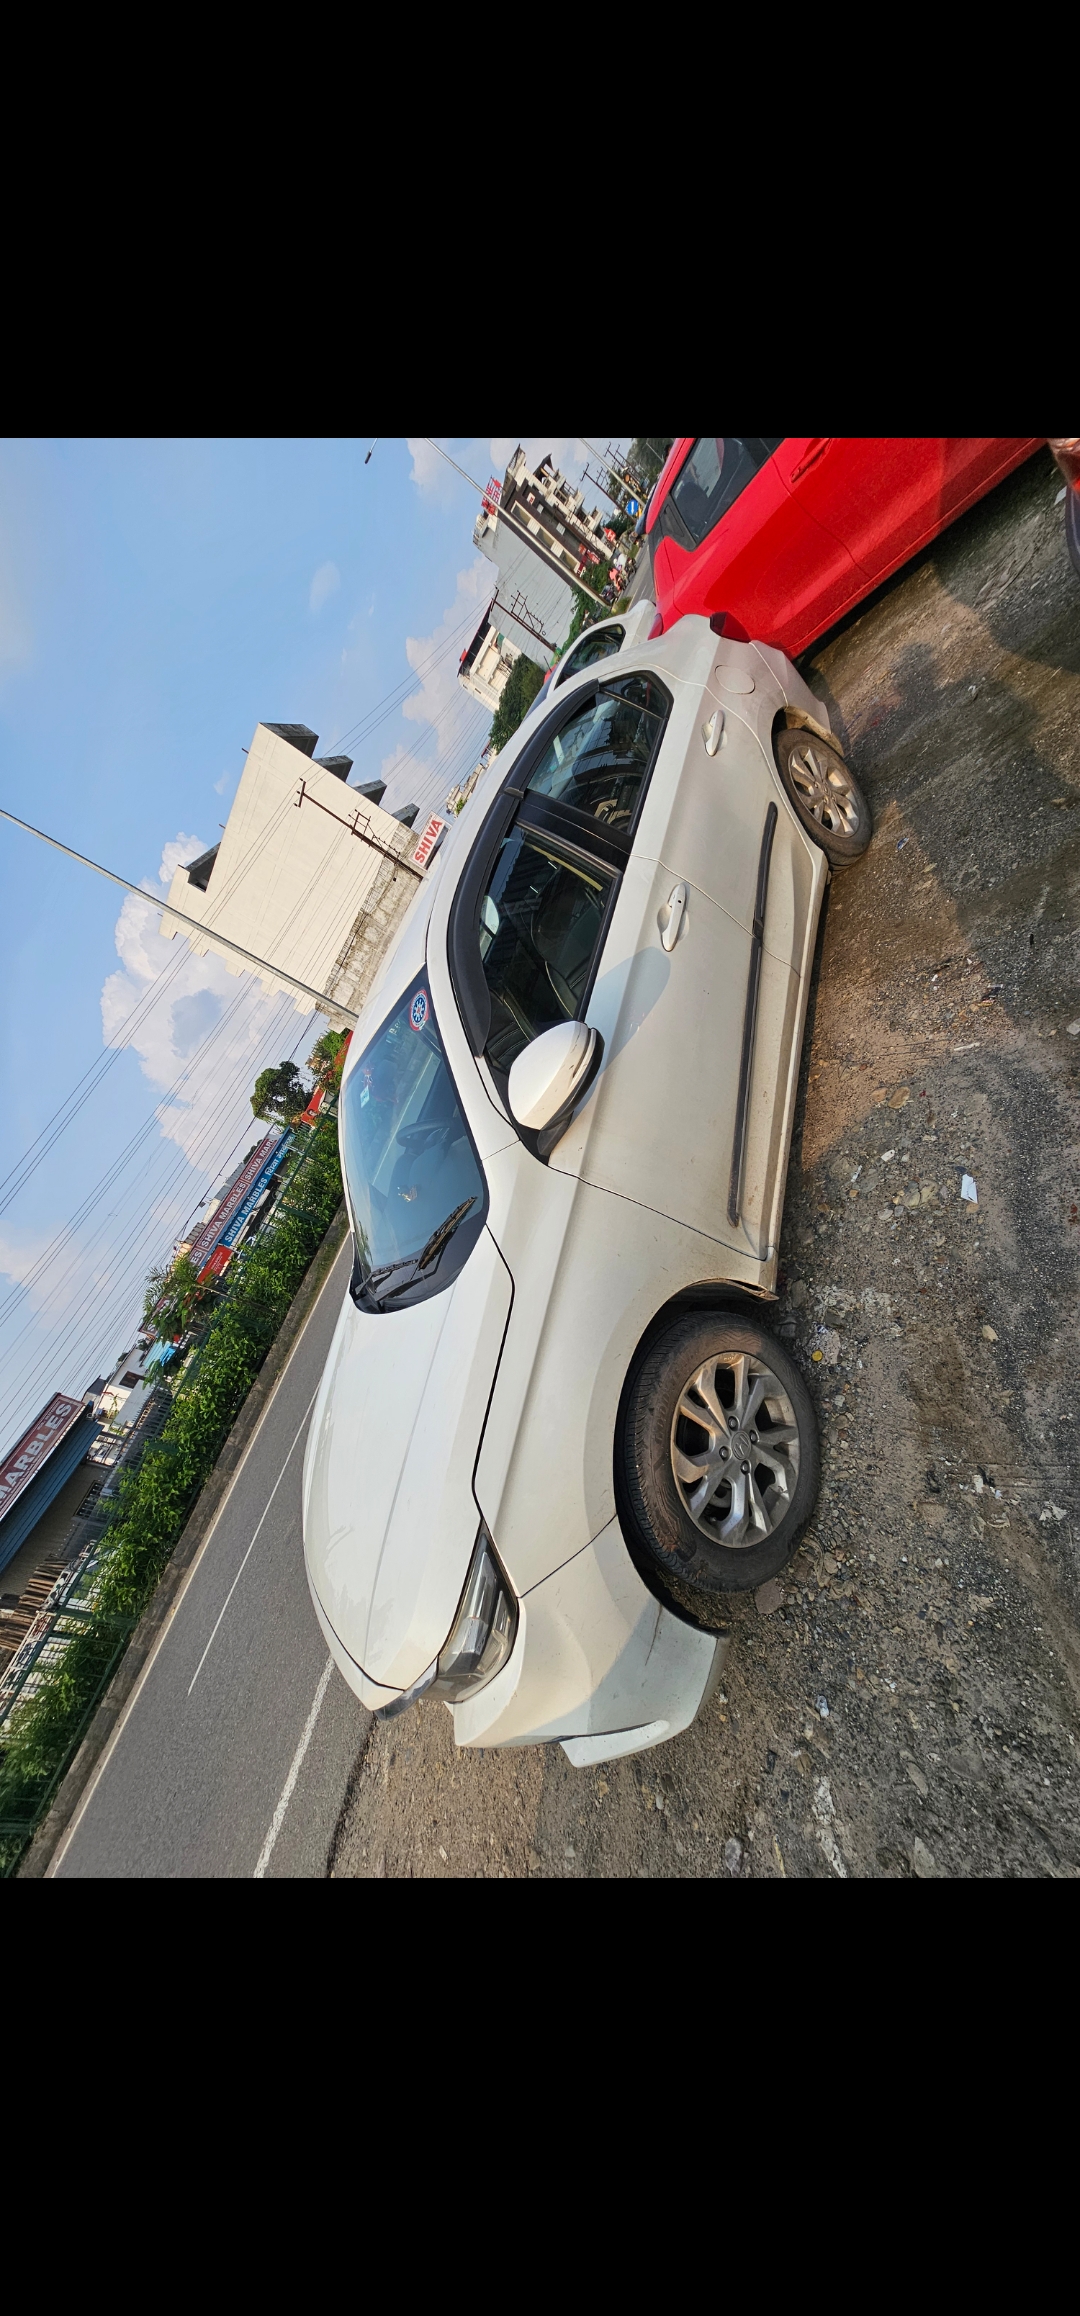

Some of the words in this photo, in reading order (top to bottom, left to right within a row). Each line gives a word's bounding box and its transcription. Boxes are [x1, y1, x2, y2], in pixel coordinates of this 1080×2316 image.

[414, 820, 442, 863] SHIVA
[245, 1156, 262, 1180] SHIVA
[201, 1219, 222, 1247] SHIVA
[218, 1181, 246, 1220] MARBLES
[224, 1214, 245, 1242] SHIVA
[241, 1176, 267, 1215] MARBLES
